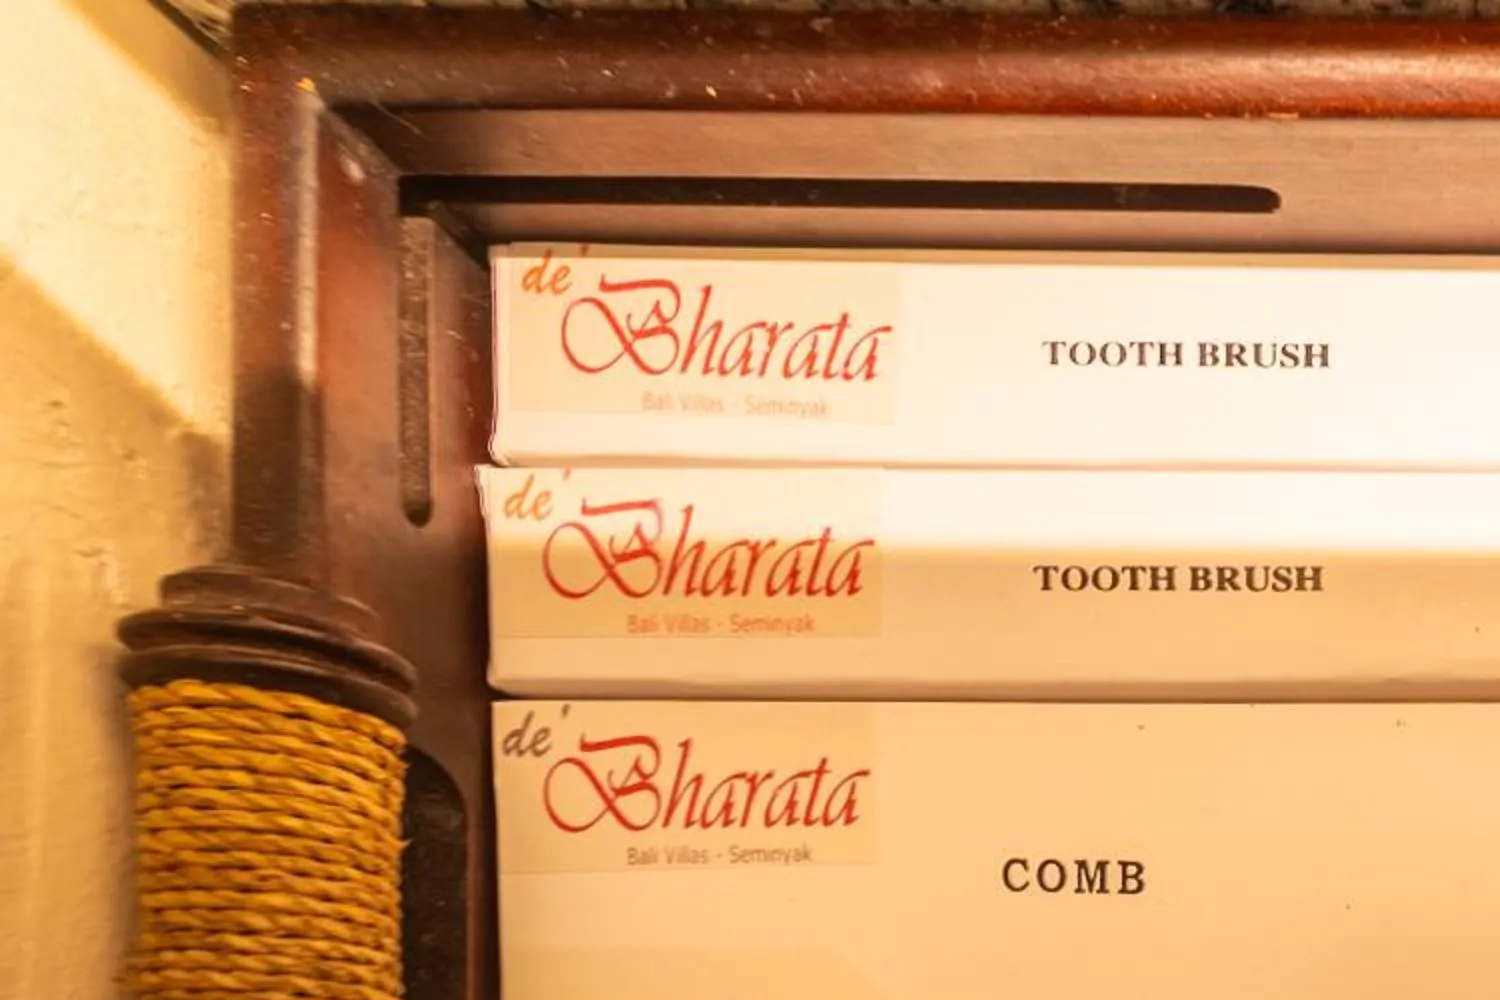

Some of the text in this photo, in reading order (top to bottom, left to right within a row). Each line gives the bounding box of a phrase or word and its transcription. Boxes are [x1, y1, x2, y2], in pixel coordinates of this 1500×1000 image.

[561, 273, 893, 382] Bharata
[1042, 341, 1330, 369] TOOTH BRUSH
[541, 498, 875, 600] Bharata
[1033, 565, 1323, 593] TOOTH BRUSH
[627, 613, 660, 633] Bali
[664, 613, 711, 633] Villas
[729, 613, 815, 637] Seminyak
[543, 733, 872, 833] Bharata
[626, 846, 659, 866] Bali
[664, 846, 710, 865] Villas
[728, 845, 813, 866] Seminyak
[1003, 858, 1146, 895] COMB
